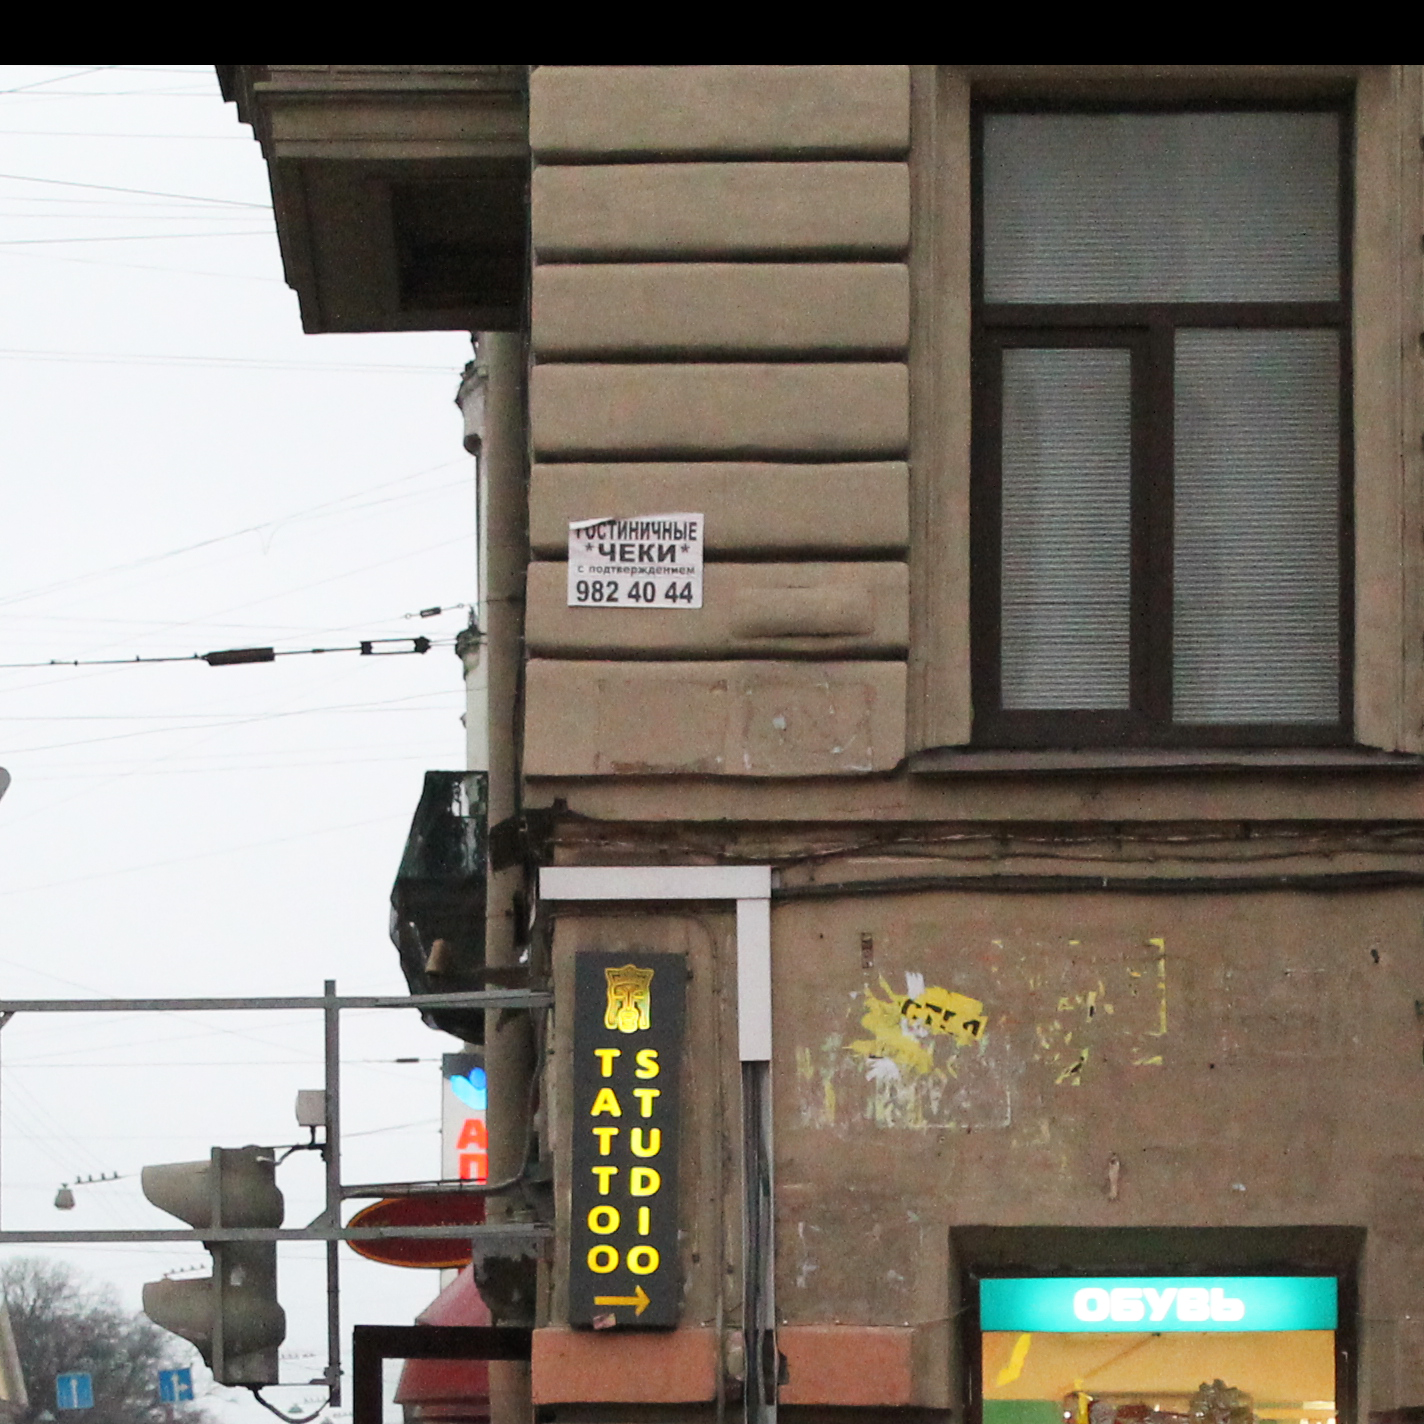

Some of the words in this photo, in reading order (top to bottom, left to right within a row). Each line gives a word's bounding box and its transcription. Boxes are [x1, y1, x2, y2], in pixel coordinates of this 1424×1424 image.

[598, 543, 676, 562] ЧЕКИ
[589, 565, 695, 577] подтверждением
[577, 579, 618, 602] 982
[627, 580, 656, 602] 40
[665, 580, 693, 603] 44
[586, 1047, 622, 1275] TATTOO
[626, 1048, 662, 1276] STUDIO
[1073, 1286, 1245, 1322] ОБУВЬ
